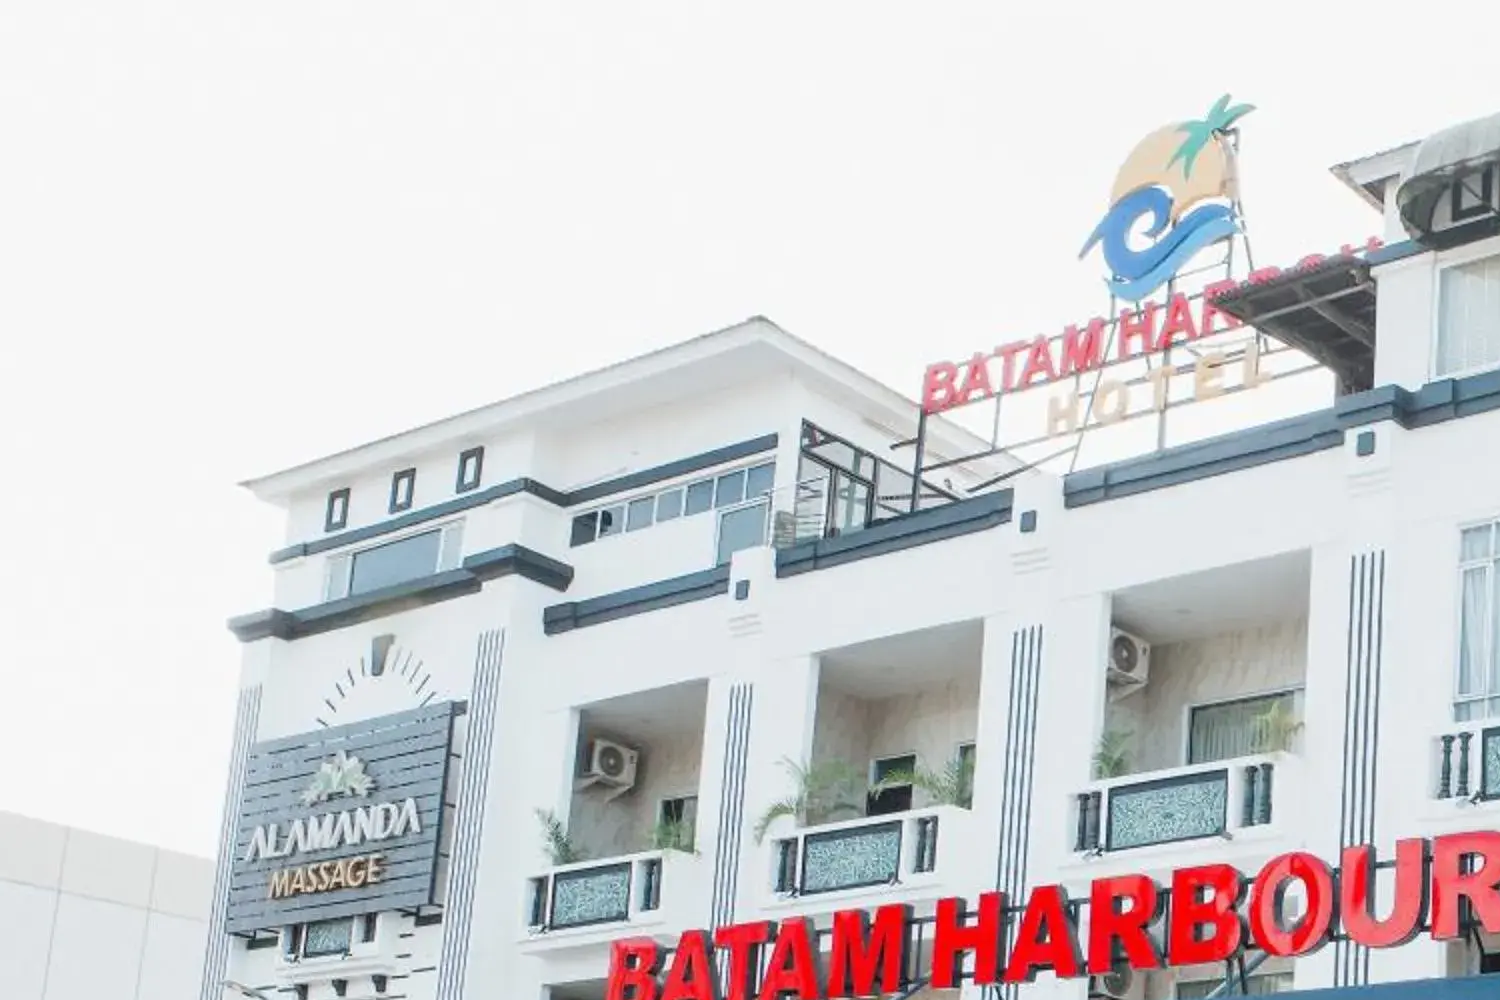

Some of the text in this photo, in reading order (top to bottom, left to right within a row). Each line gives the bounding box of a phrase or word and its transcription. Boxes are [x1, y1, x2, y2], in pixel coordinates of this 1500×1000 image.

[922, 316, 1105, 416] BATAM
[1046, 342, 1271, 437] HOTEL
[244, 797, 422, 862] ALAMANDA
[268, 853, 386, 899] MASSAGE
